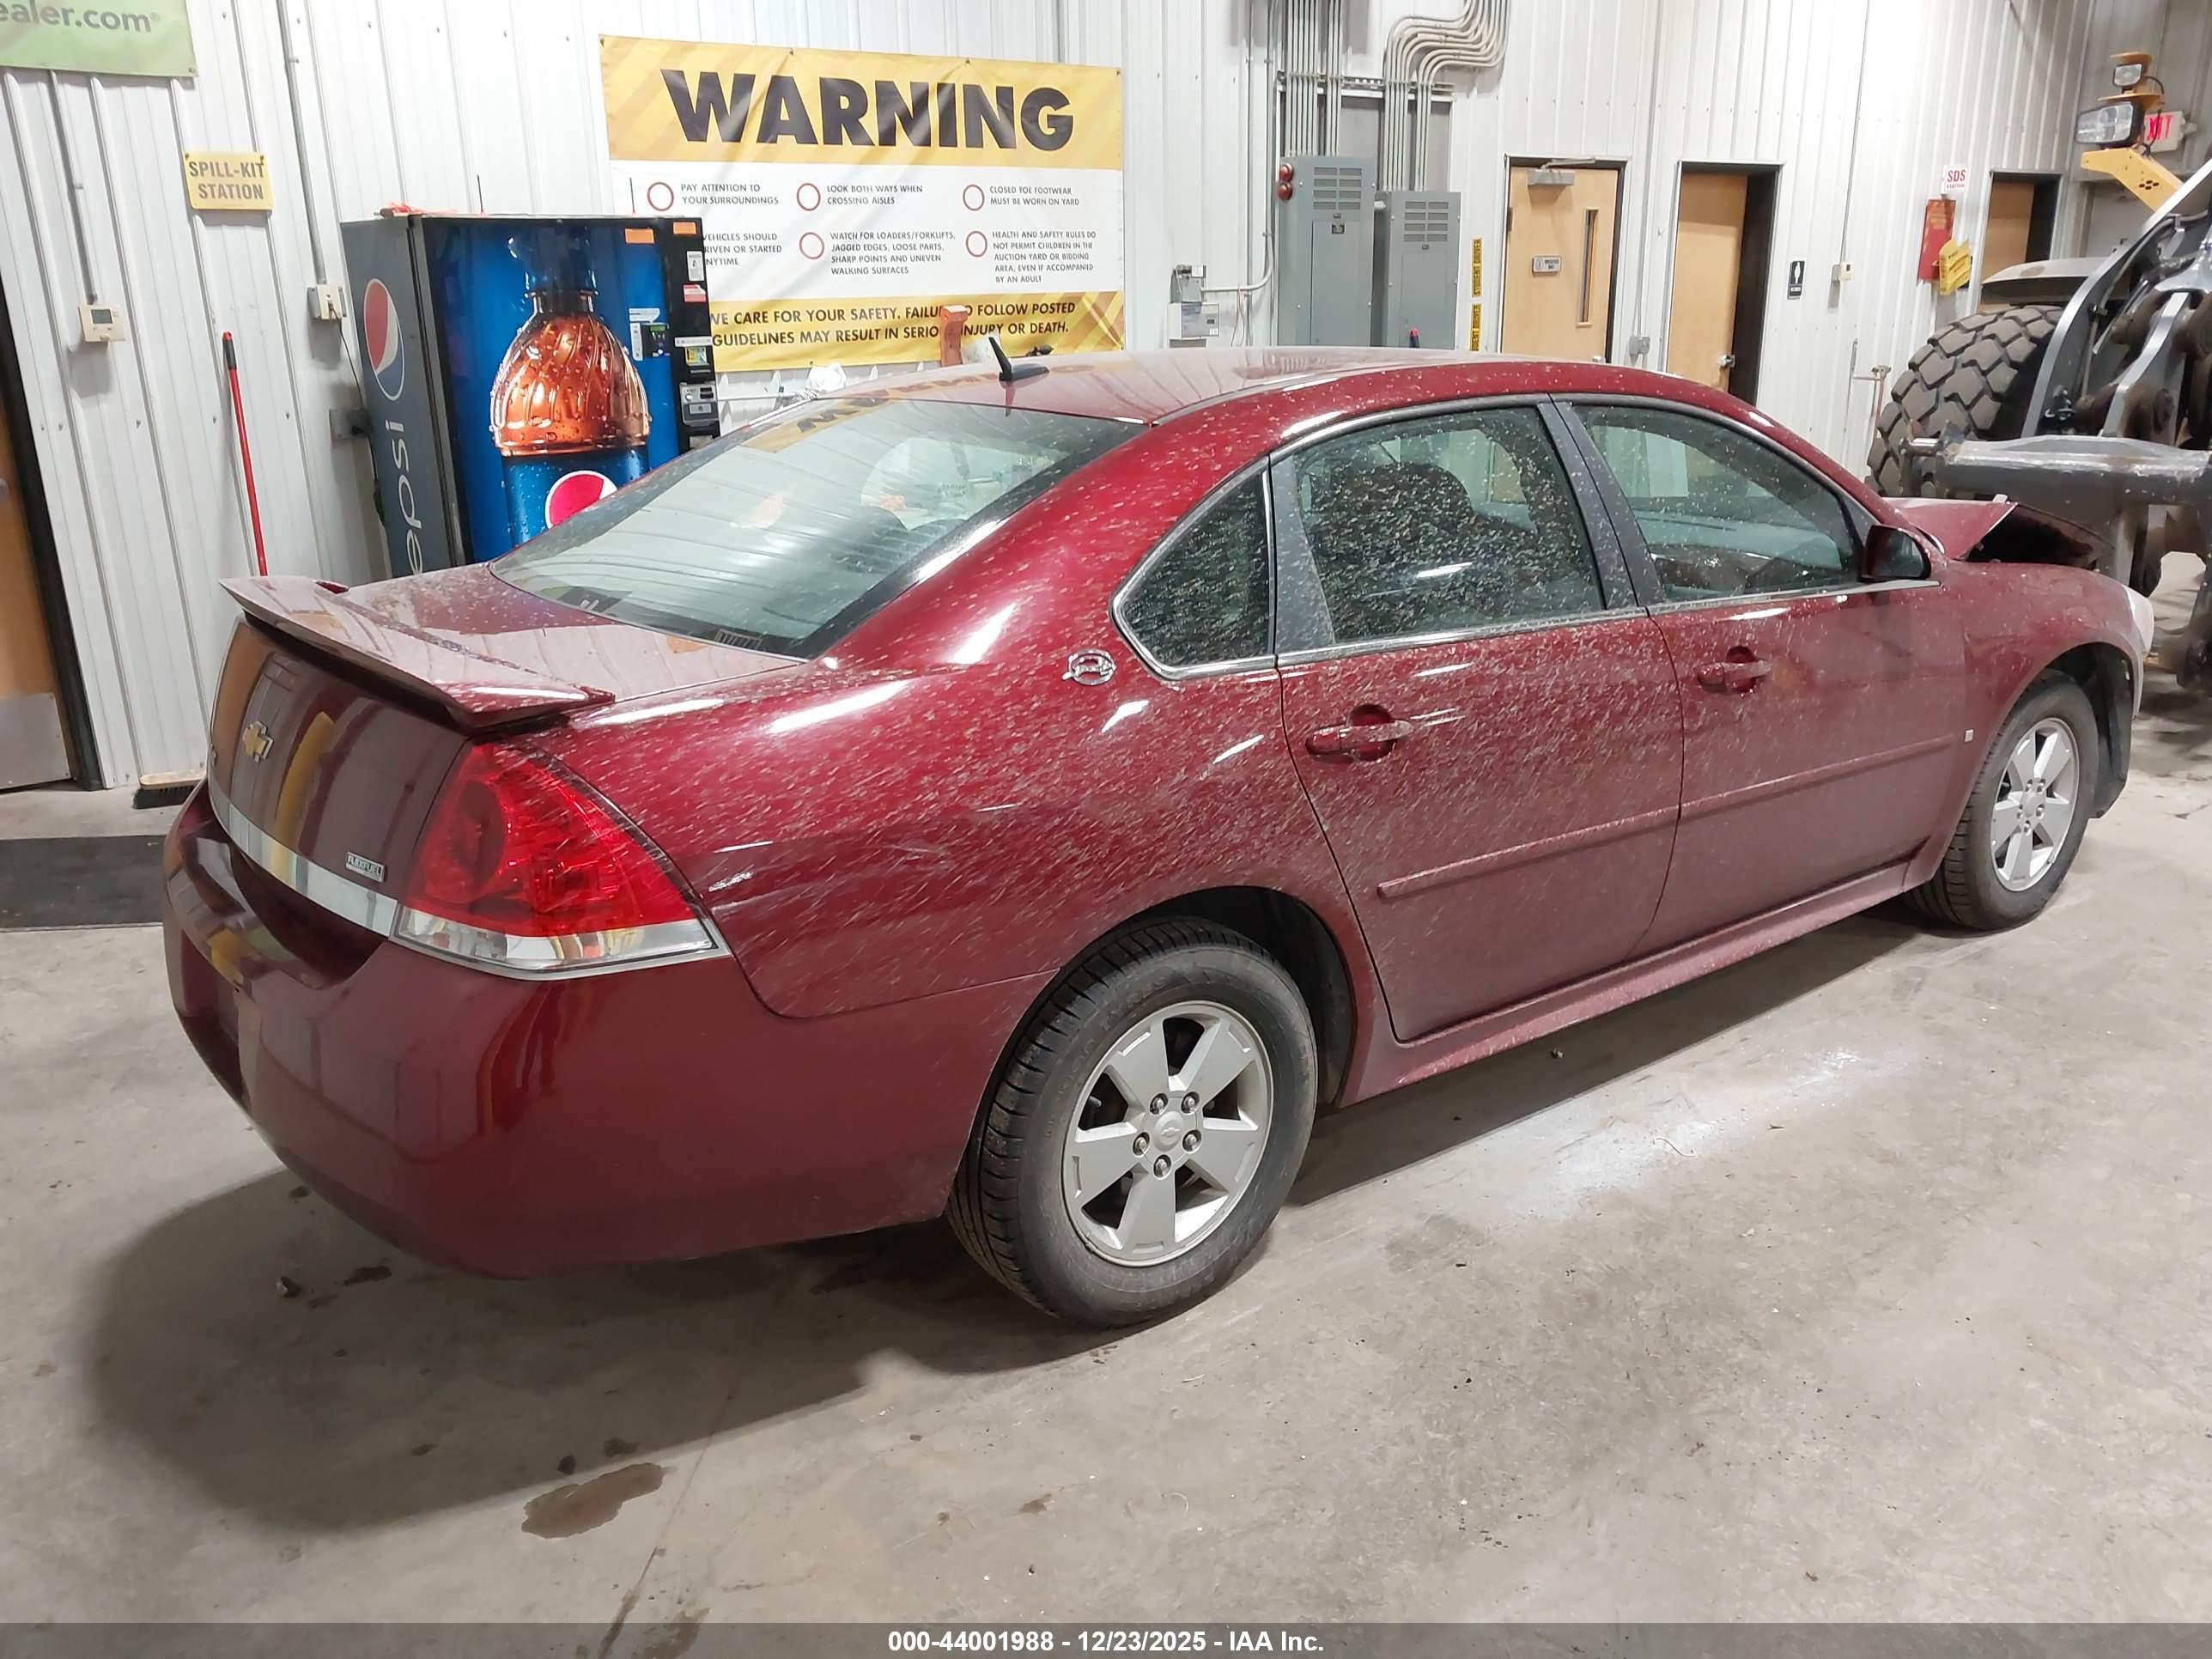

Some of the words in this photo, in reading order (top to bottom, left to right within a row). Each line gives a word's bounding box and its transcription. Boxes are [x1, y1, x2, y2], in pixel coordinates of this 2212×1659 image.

[659, 69, 1074, 151] WARNING
[2147, 114, 2173, 140] XIT
[189, 161, 264, 178] SPILL-KIT
[1947, 169, 1966, 182] SDS
[198, 183, 264, 199] STATION
[827, 184, 848, 192] LOOK
[851, 184, 873, 192] BOTH
[875, 184, 898, 192] WAYS
[900, 184, 923, 192] WHEN
[827, 197, 869, 205] CROSSING
[872, 197, 895, 205] AISLES
[830, 232, 857, 240] WATCH
[860, 232, 874, 240] FOR
[734, 311, 769, 324] CARE
[774, 310, 802, 323] FOR
[806, 308, 846, 322] YOUR
[851, 307, 901, 320] SAFETY.
[905, 306, 943, 319] FAILU
[977, 303, 1028, 315] FOLLOW
[1032, 301, 1075, 314] POSTED
[713, 331, 794, 347] GUIDELINES
[799, 330, 830, 343] MAY
[836, 328, 881, 342] RESULT
[884, 327, 898, 339] IN
[903, 325, 939, 338] SERIO
[1008, 322, 1025, 334] OR
[1030, 321, 1068, 334] DEATH.
[386, 419, 422, 576] epsi
